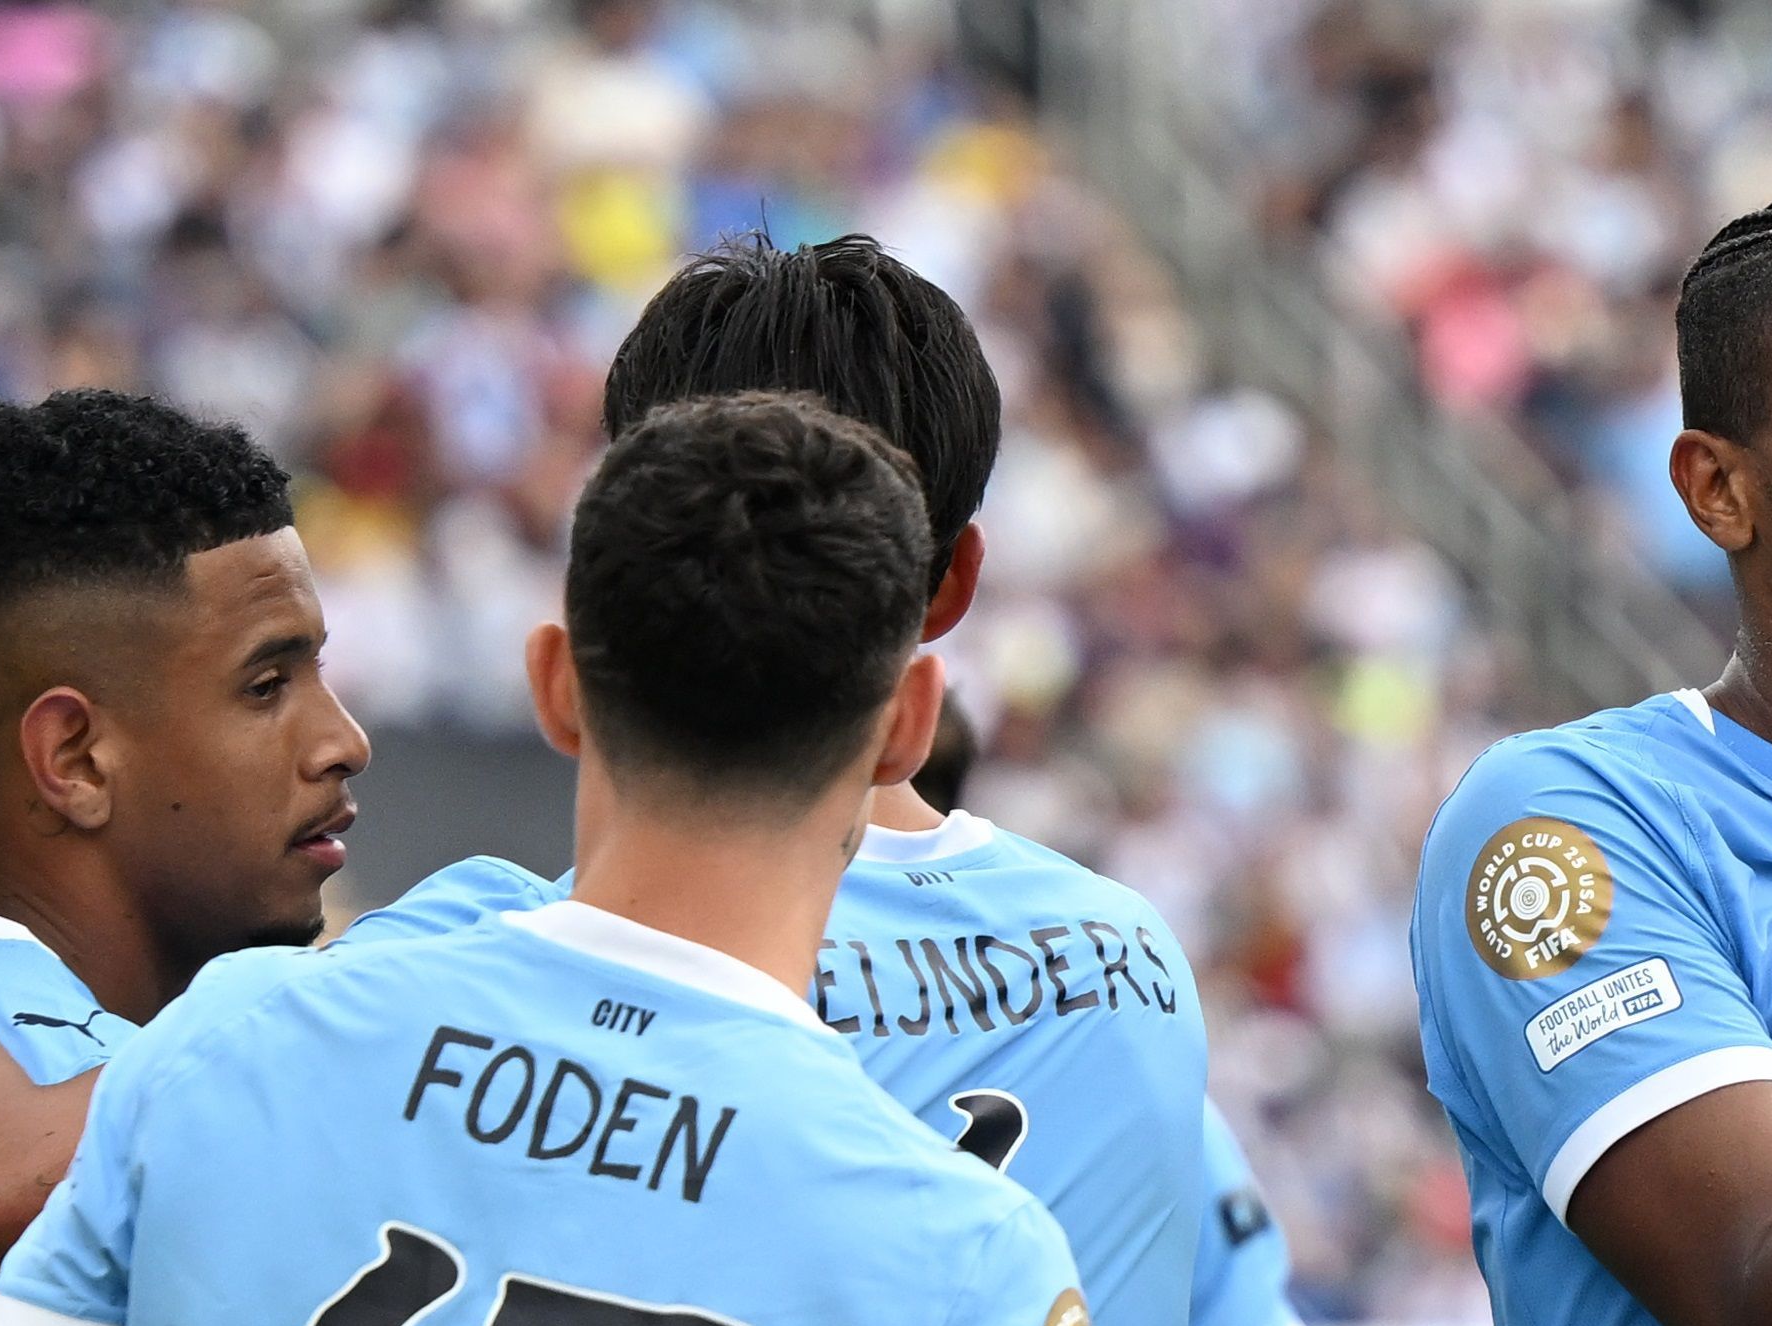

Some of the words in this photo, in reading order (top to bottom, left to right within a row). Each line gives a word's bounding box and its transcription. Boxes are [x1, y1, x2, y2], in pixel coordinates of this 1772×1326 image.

[1521, 833, 1563, 849] CUP
[1563, 846, 1588, 869] 25
[1477, 842, 1516, 912] WORLD
[1576, 873, 1595, 915] USA
[1480, 918, 1513, 959] CLUB
[1524, 927, 1582, 970] FIFA
[811, 920, 1176, 1037] EIJNDERS
[591, 998, 657, 1036] CITY
[1538, 989, 1603, 1035] FOOTBALL
[1603, 968, 1654, 999] UNITES
[1624, 989, 1663, 1016] FIFA
[1546, 1033, 1573, 1056] the
[1571, 1002, 1621, 1040] World
[404, 1024, 739, 1204] FODEN
